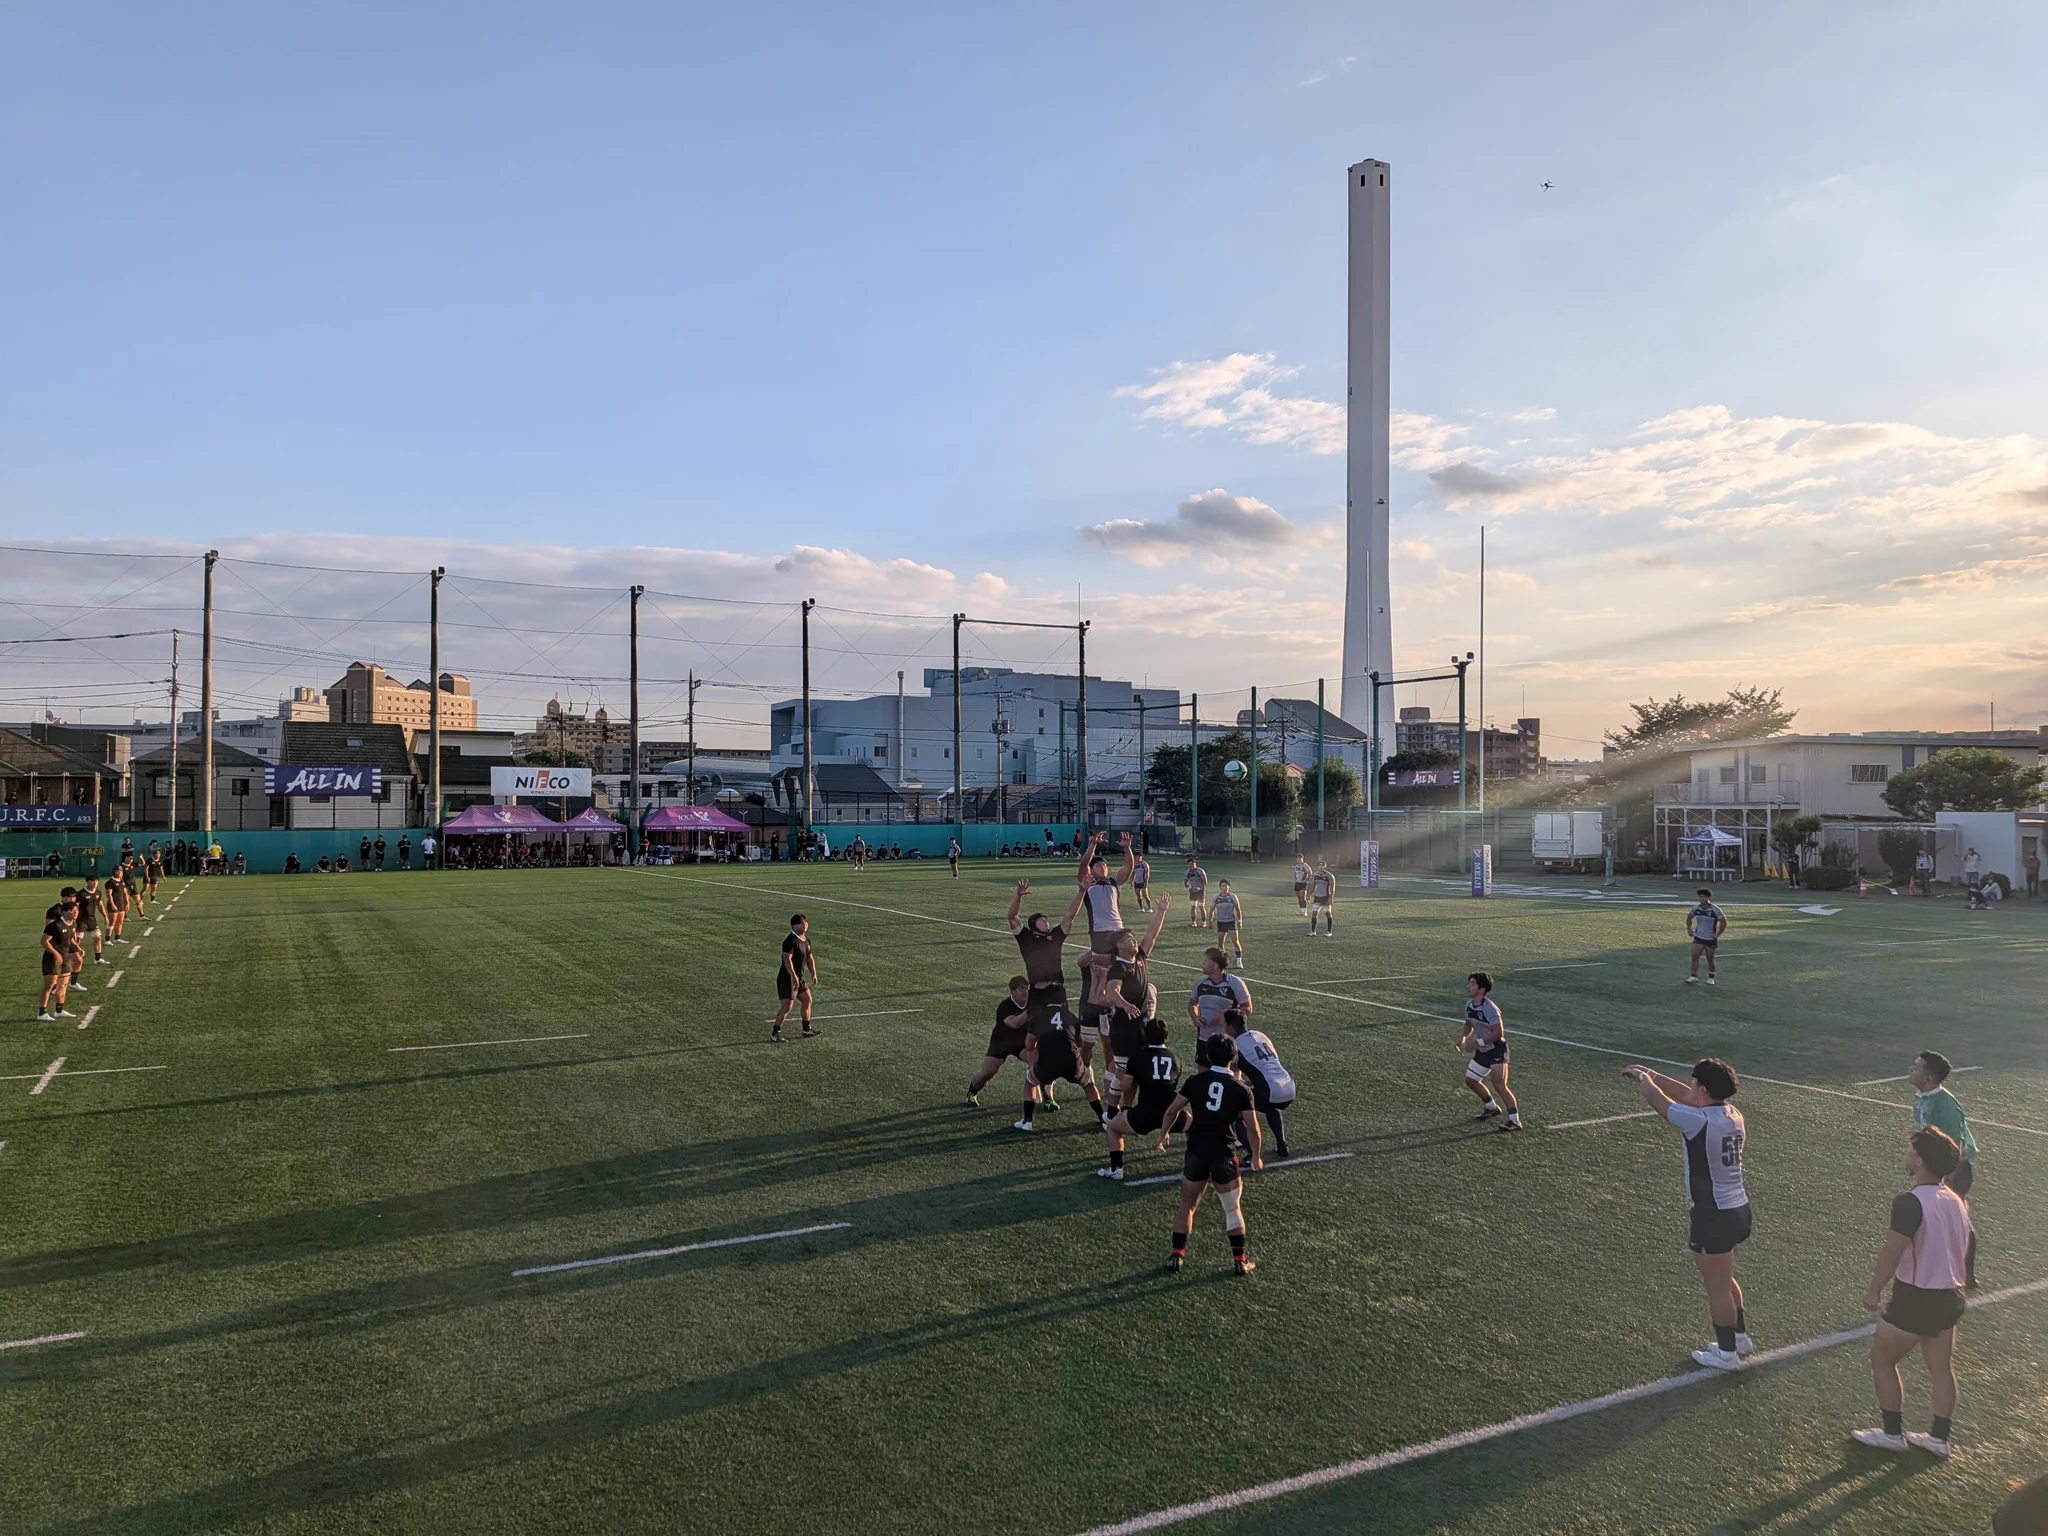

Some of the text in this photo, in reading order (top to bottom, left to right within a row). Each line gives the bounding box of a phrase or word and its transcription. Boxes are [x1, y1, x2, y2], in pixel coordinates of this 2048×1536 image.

[284, 769, 363, 794] ALL IN
[515, 776, 570, 789] NIFCO
[1474, 862, 1482, 889] MEIJI
[1050, 1011, 1063, 1030] 4
[1252, 1043, 1279, 1062] 44
[1151, 1055, 1172, 1080] 17
[1205, 1081, 1224, 1112] 9
